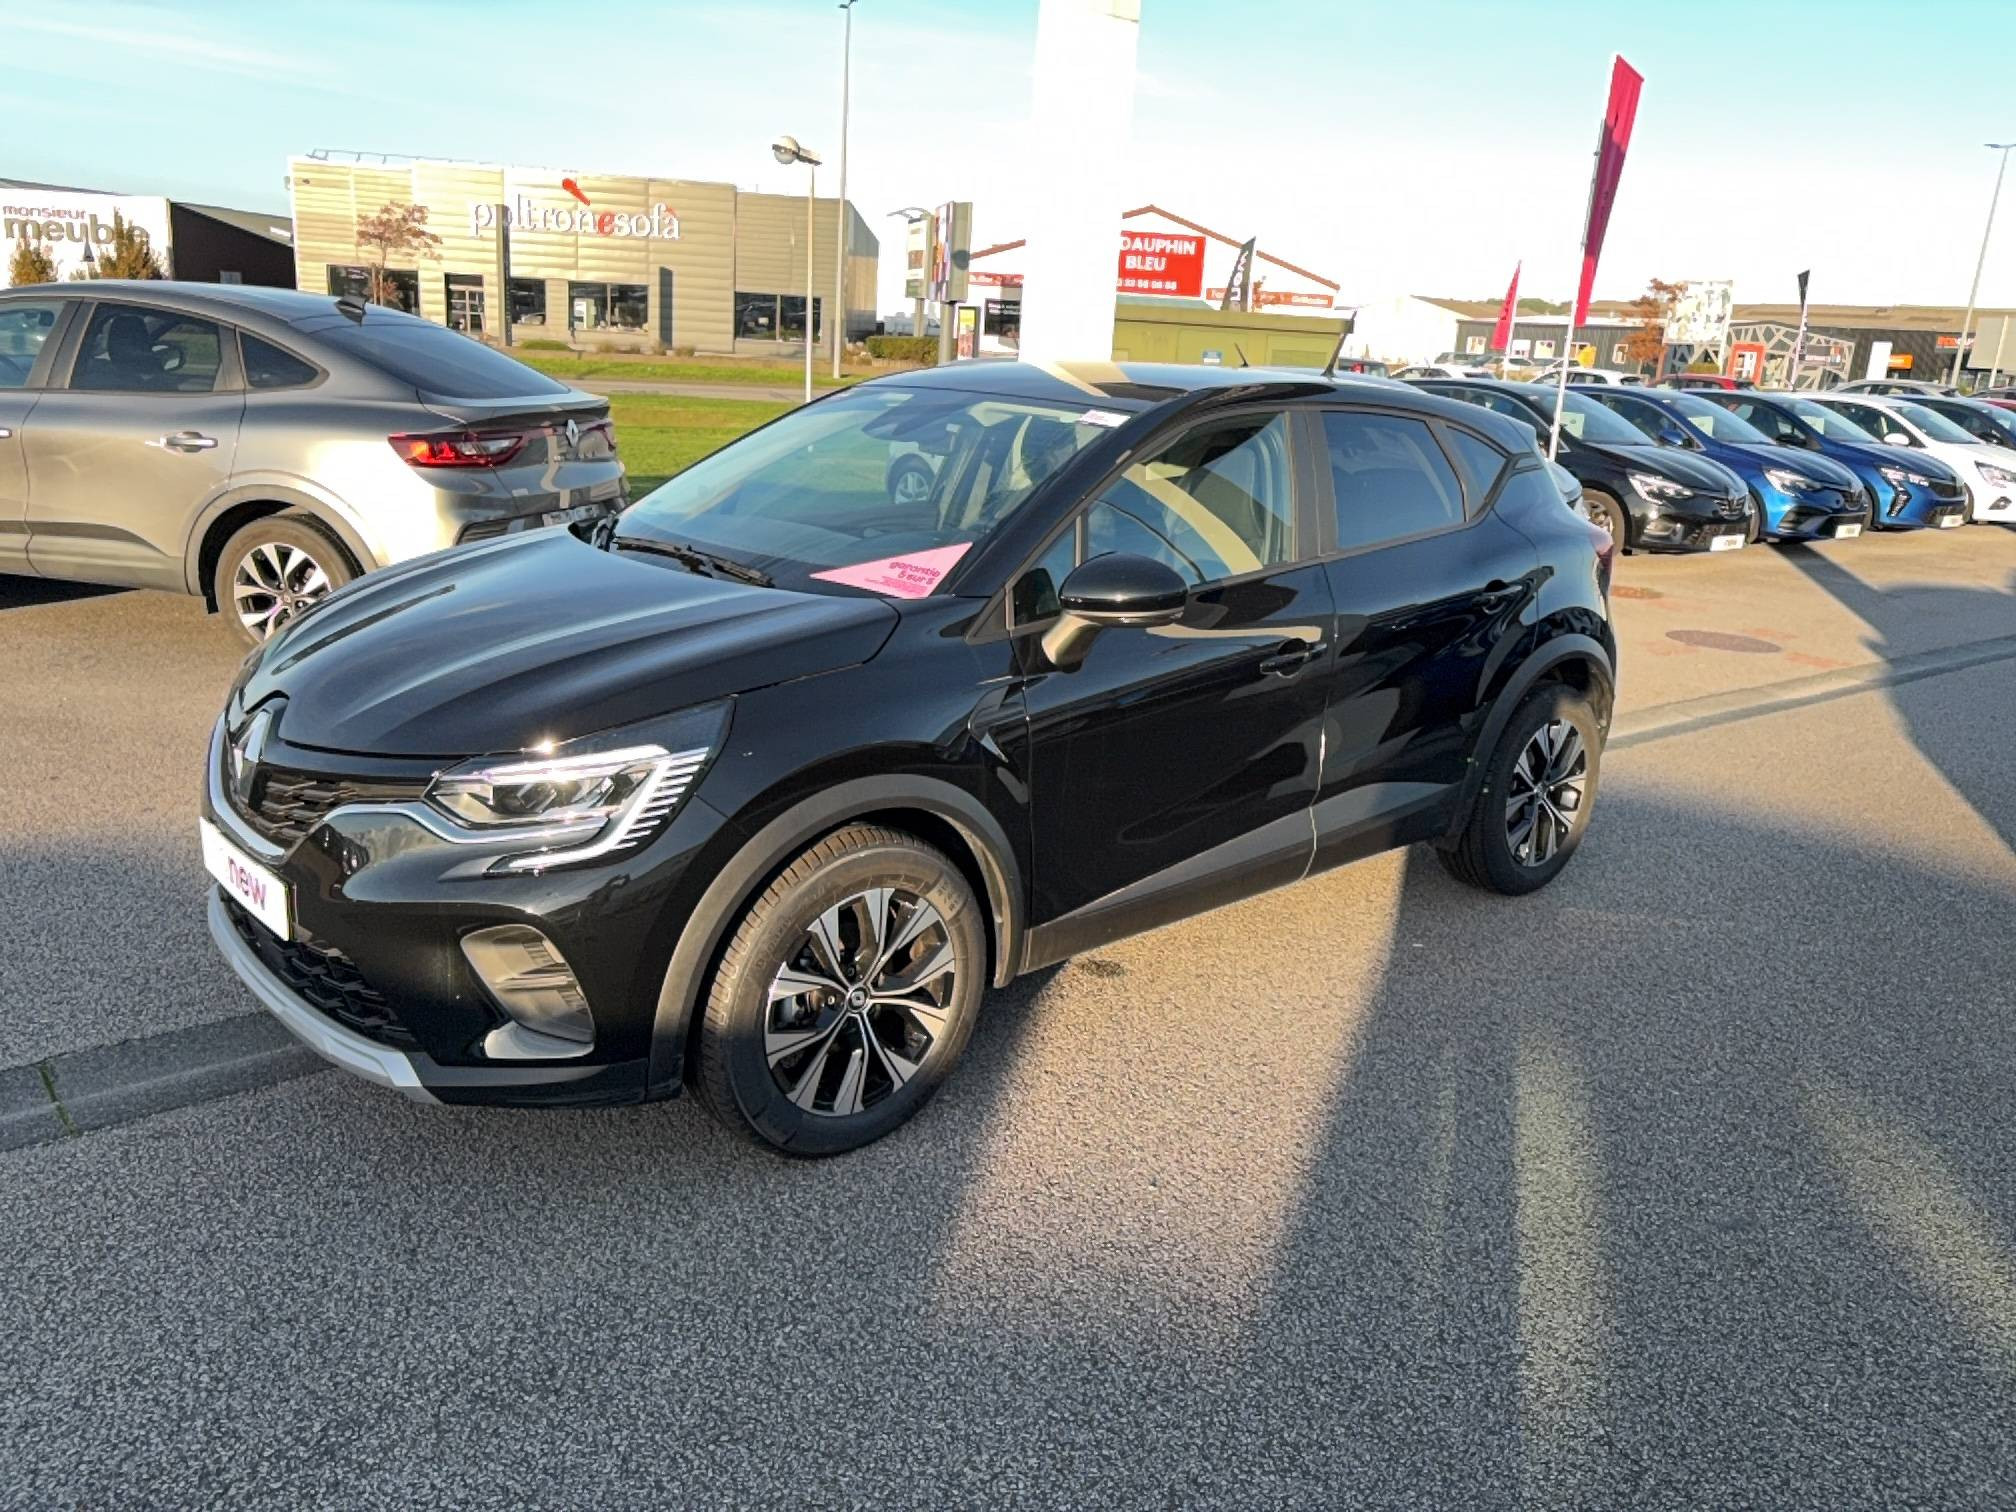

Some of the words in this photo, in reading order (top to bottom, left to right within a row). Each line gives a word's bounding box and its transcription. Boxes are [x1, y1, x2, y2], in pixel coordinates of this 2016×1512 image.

[3, 205, 87, 219] monsieur
[1120, 237, 1197, 255] DAUPHIN
[1125, 255, 1167, 271] BLEU
[228, 856, 266, 911] new
